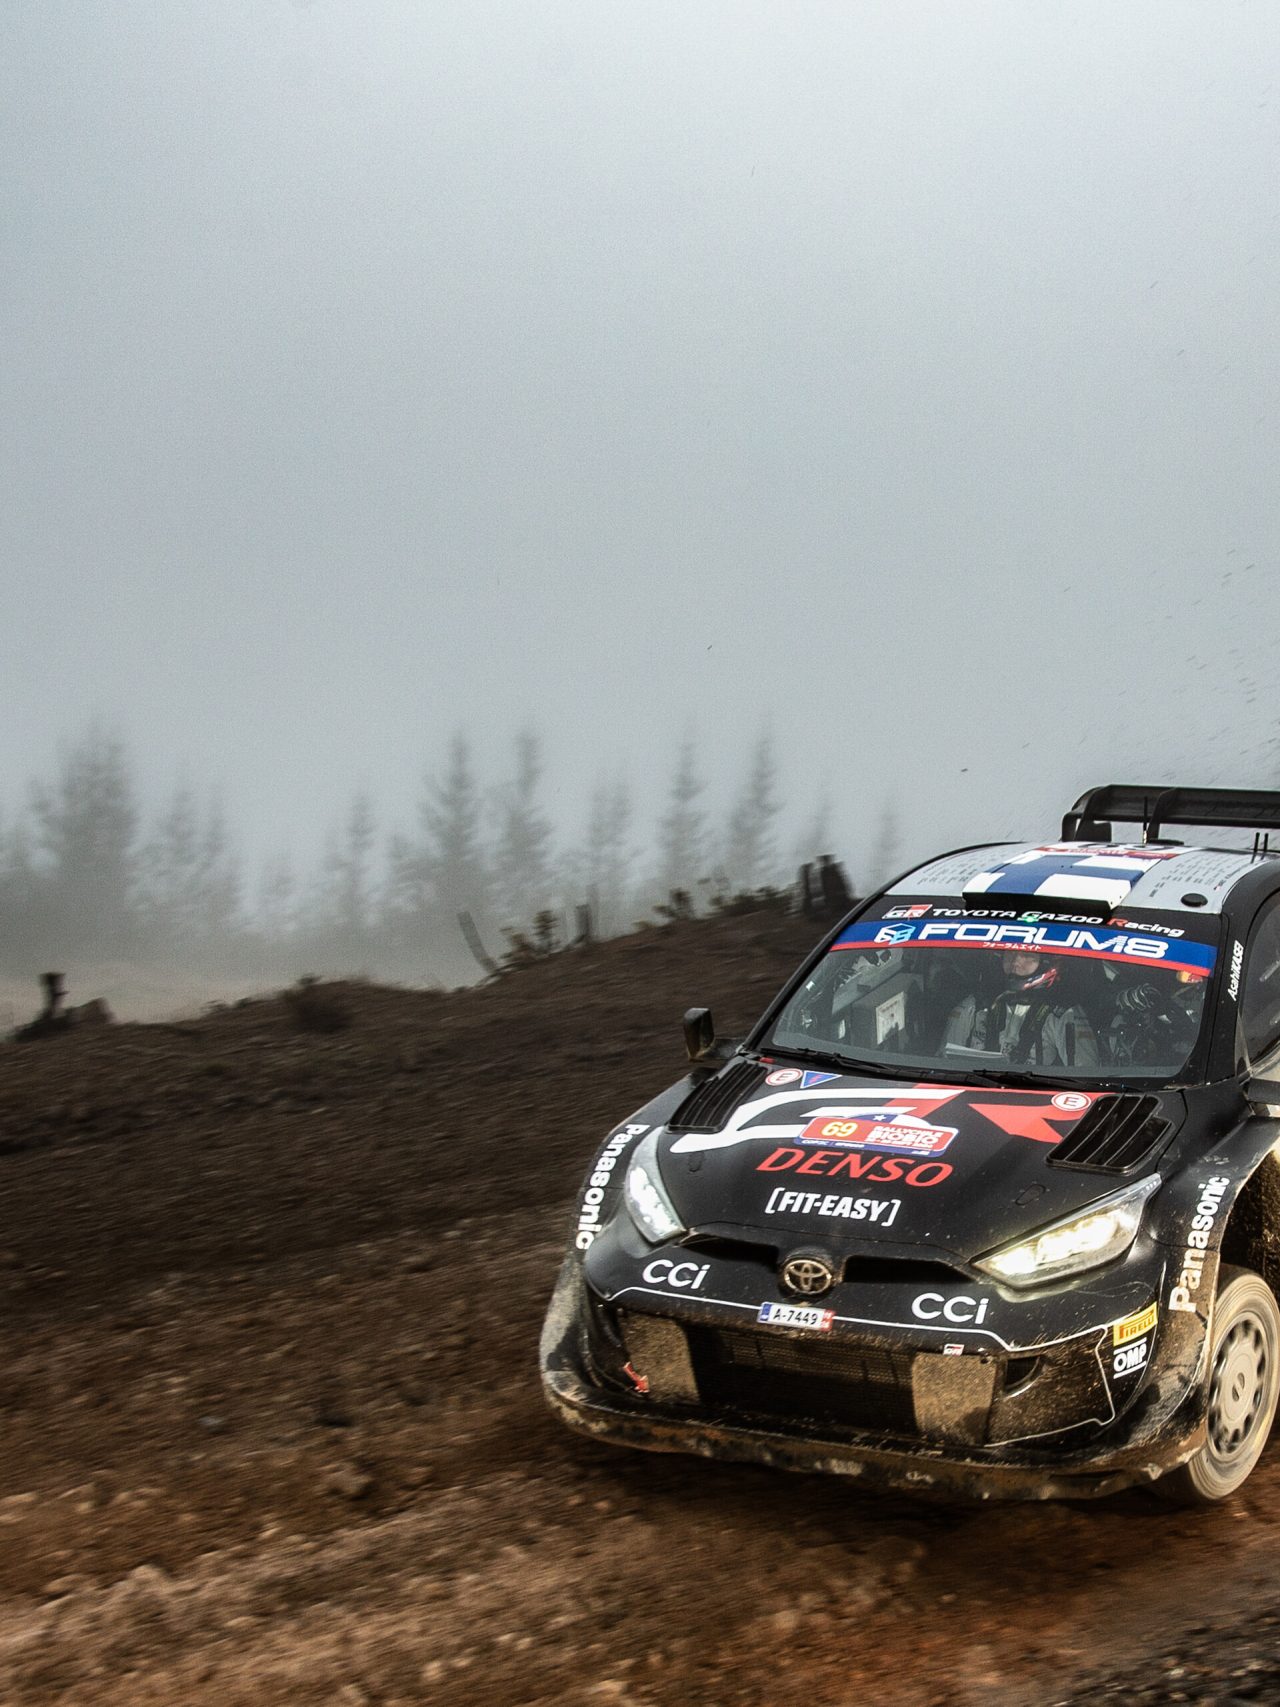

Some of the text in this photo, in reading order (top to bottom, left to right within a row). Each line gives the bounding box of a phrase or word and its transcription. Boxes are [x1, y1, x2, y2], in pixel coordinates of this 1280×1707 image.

[932, 908, 1016, 918] TOYOTA
[1106, 917, 1185, 938] Racing
[918, 923, 1169, 959] FORUM8
[821, 1121, 859, 1138] 69
[755, 1147, 954, 1187] DENSO
[575, 1123, 651, 1250] Panasonic
[1168, 1176, 1230, 1313] Panasonic
[773, 1307, 818, 1325] A-7449
[1119, 1310, 1155, 1340] PIRELLI
[1113, 1341, 1147, 1373] OMP
